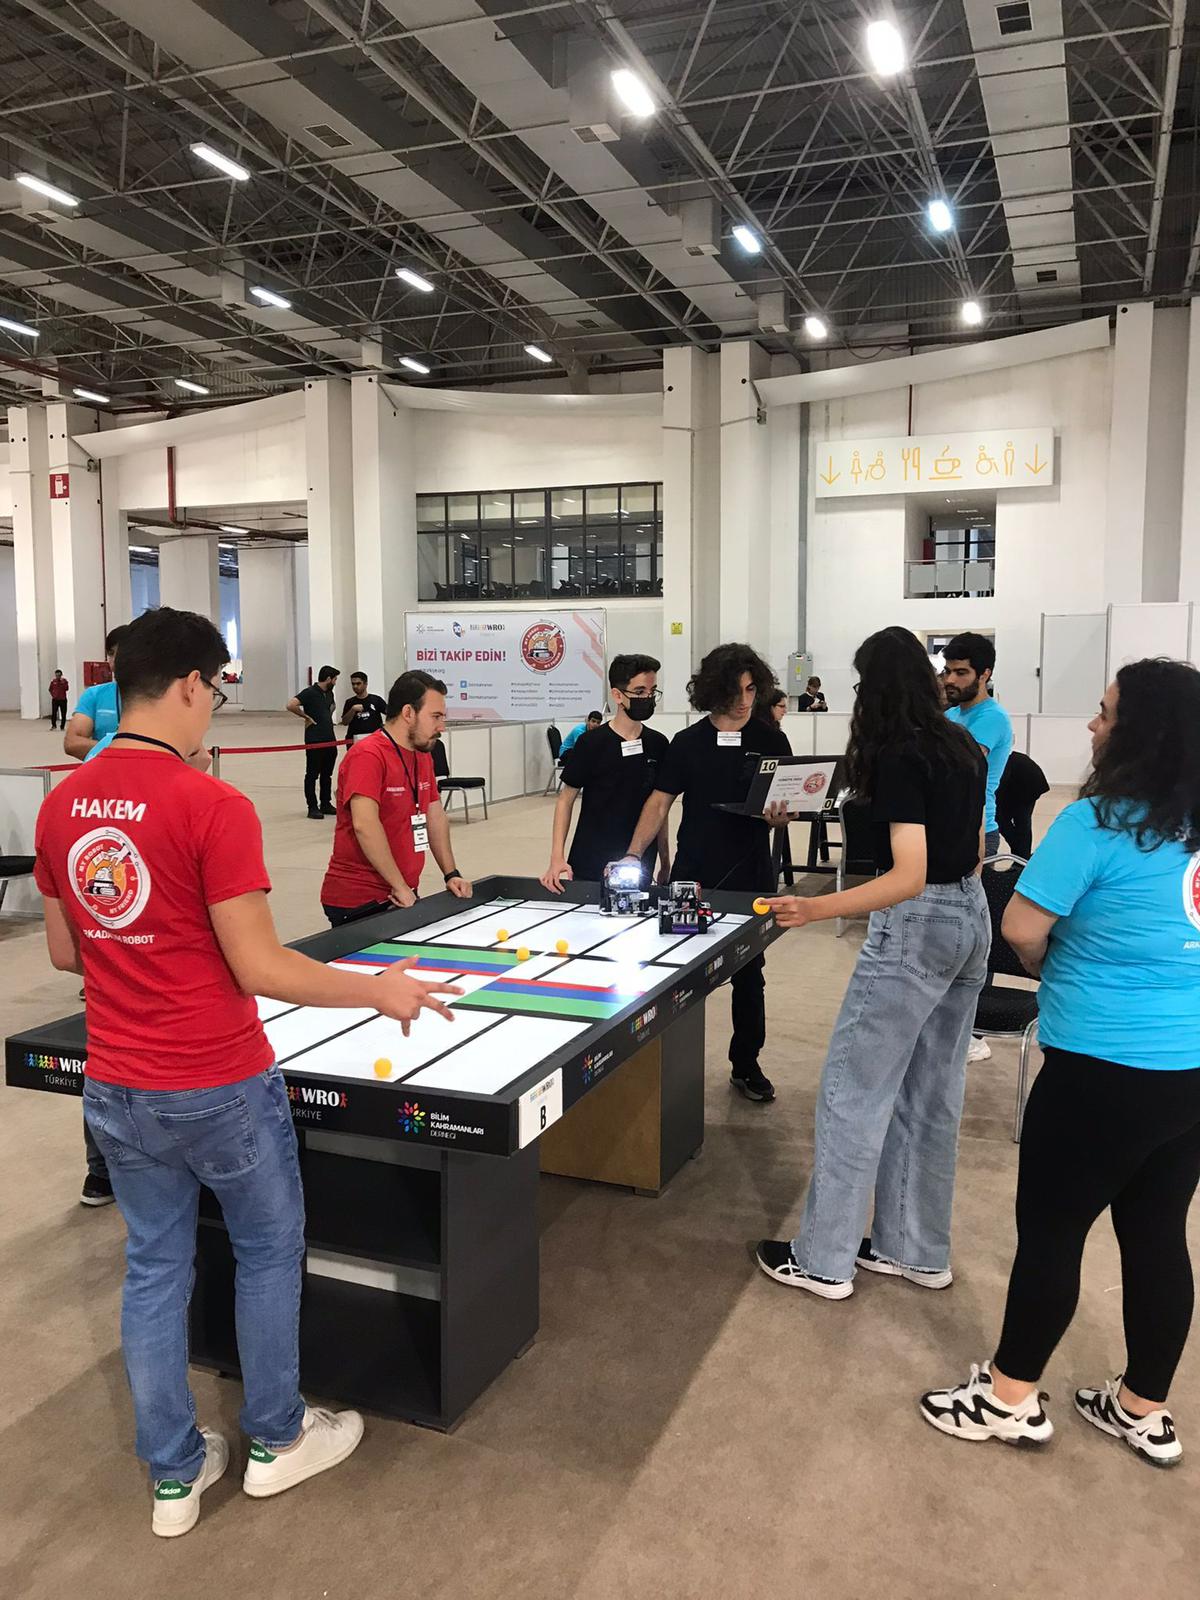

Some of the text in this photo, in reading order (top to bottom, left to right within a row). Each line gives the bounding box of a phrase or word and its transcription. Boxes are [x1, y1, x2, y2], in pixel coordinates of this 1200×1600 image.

[416, 648, 506, 661] BİZİ TAKİP EDİN!
[762, 761, 776, 772] 10
[71, 798, 146, 822] HAKEM
[84, 843, 104, 861] ROBOT
[118, 889, 134, 910] FRIEND
[123, 935, 155, 945] ROBOT
[45, 1074, 78, 1087] TÜRKİYE
[301, 1087, 340, 1107] WRO
[291, 1105, 323, 1121] ÜRKİYE
[430, 1111, 450, 1122] BİLİM
[540, 1104, 547, 1131] B
[430, 1121, 485, 1136] KAHRAMANLARI
[159, 1487, 181, 1495] adidas
